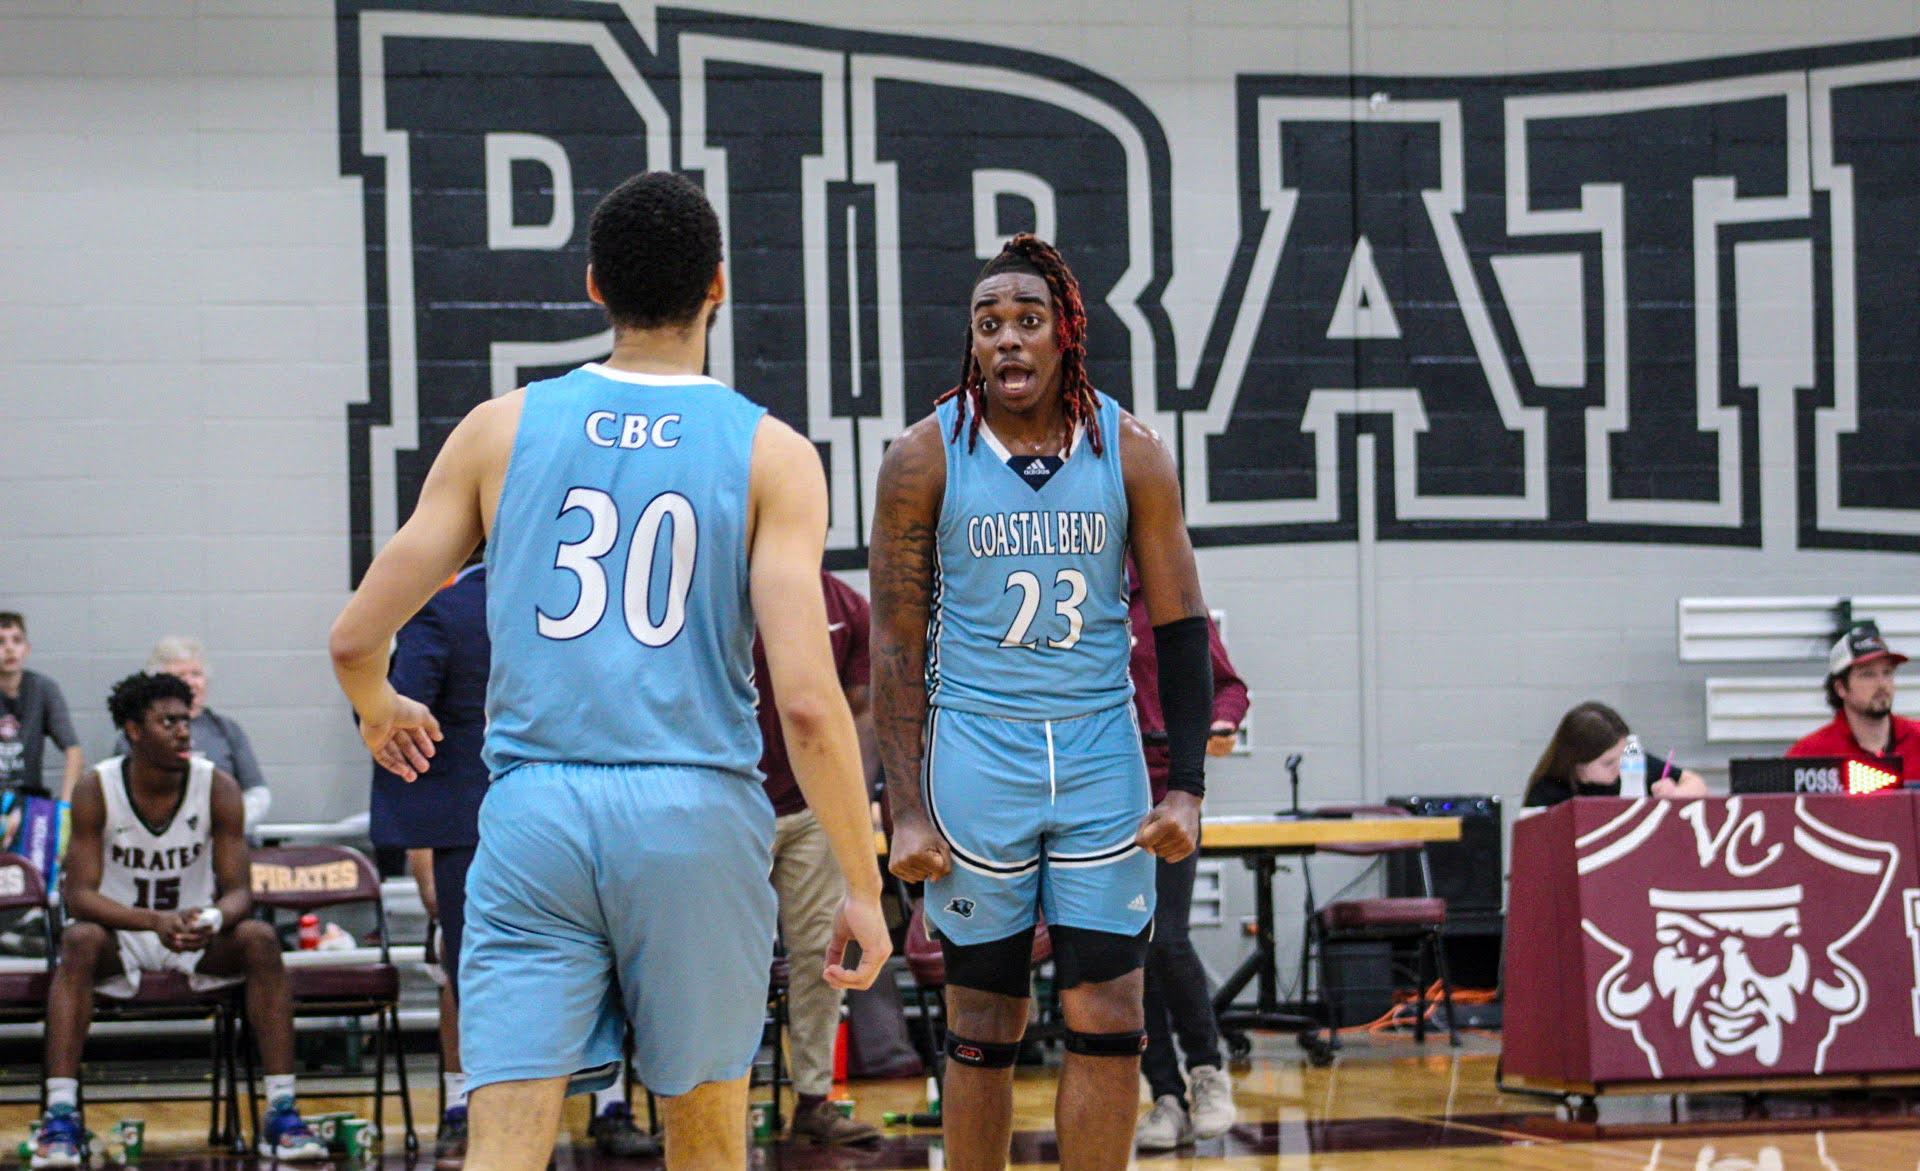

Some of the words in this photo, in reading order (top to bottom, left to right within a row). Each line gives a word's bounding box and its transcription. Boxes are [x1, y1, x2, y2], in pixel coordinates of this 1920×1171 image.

[584, 410, 682, 450] CBC
[967, 512, 1058, 559] COASTAL
[1057, 511, 1107, 555] BEND
[535, 486, 699, 648] 30
[997, 568, 1088, 651] 23
[1794, 767, 1844, 792] POSS.
[1679, 796, 1784, 878] VC
[133, 876, 181, 910] 15
[251, 860, 359, 893] PIRATES
